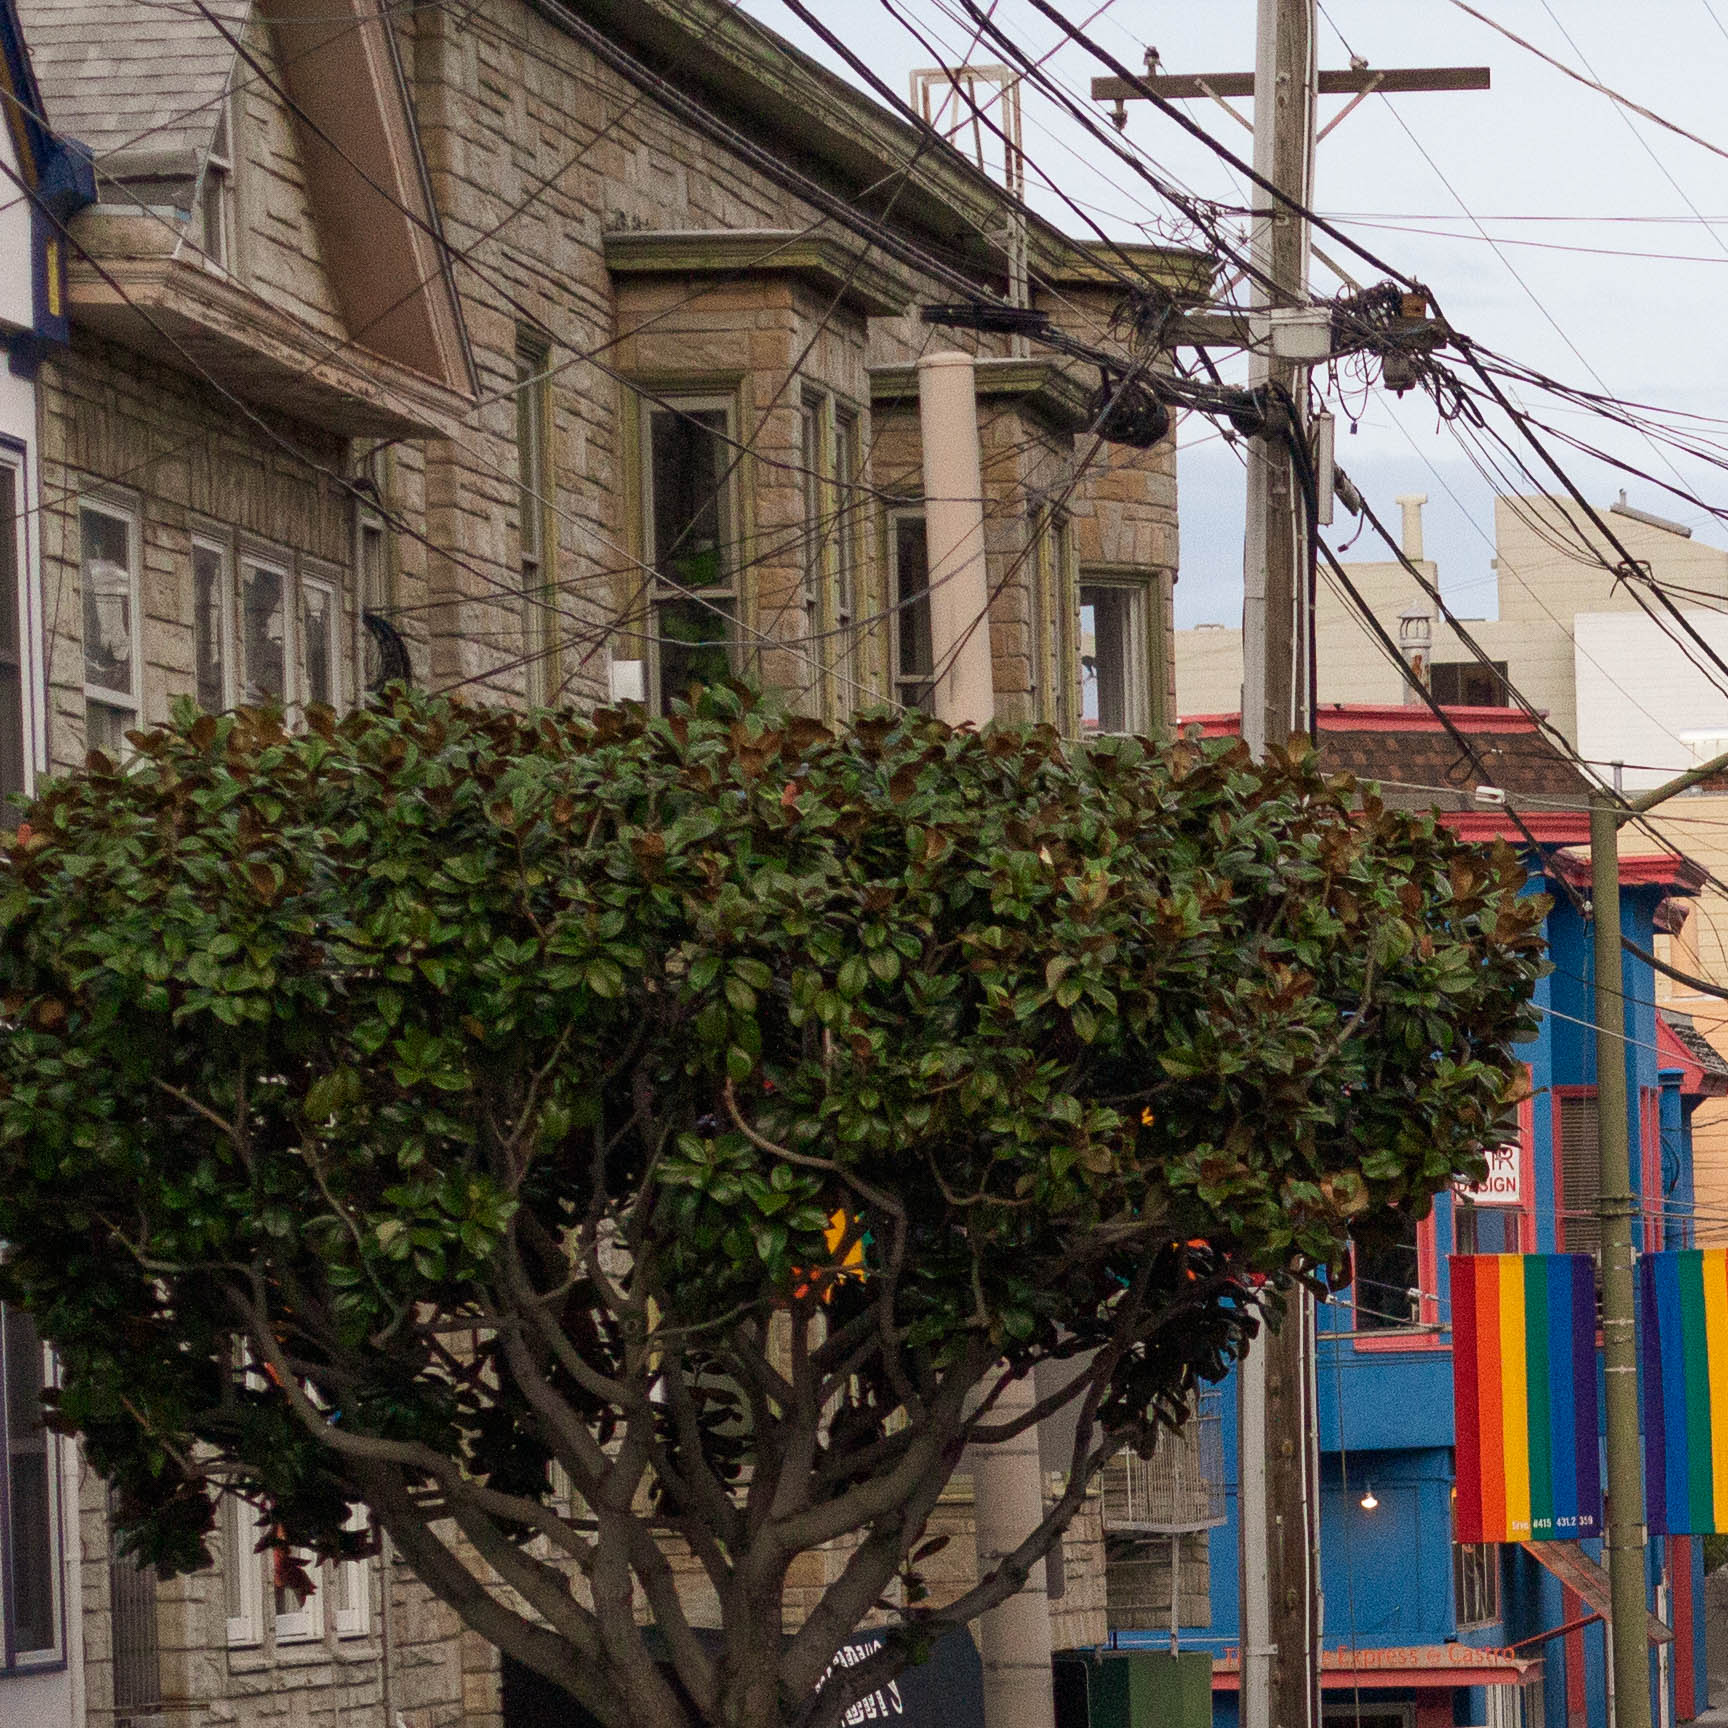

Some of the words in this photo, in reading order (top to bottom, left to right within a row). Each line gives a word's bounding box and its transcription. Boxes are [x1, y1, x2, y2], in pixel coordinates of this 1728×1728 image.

[1457, 1176, 1516, 1193] DSIGN
[1336, 1644, 1419, 1668] Express
[1447, 1643, 1516, 1665] Castro
